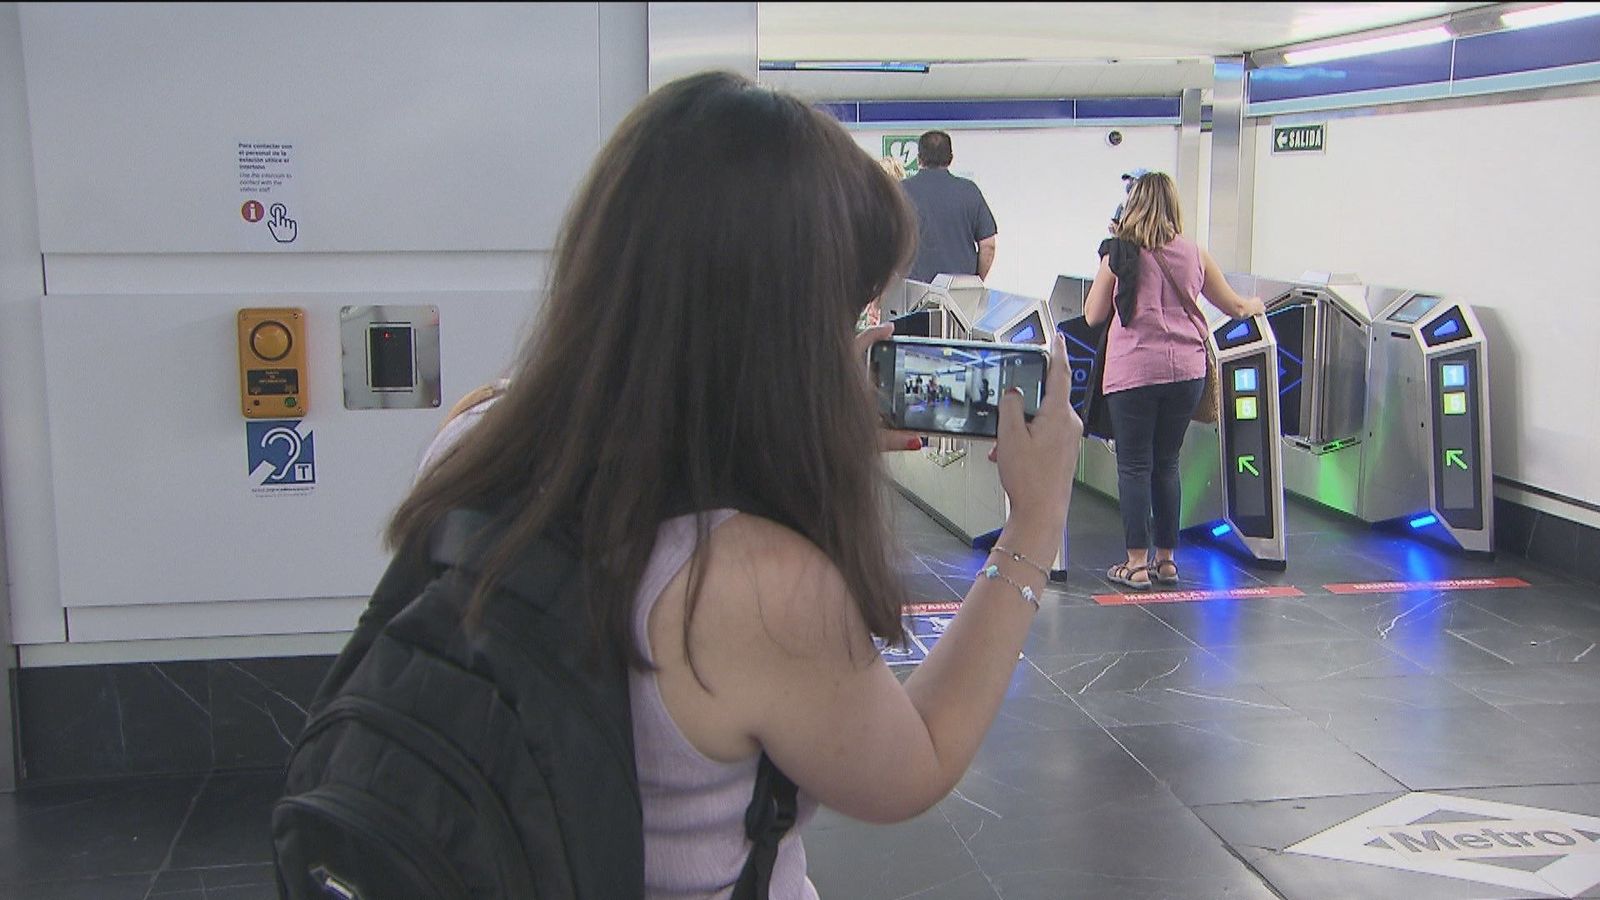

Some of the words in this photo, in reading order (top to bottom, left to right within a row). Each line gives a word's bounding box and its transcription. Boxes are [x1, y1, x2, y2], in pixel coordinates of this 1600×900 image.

[1289, 129, 1321, 148] SALIDA
[298, 465, 309, 480] T
[1388, 828, 1577, 853] Metro
